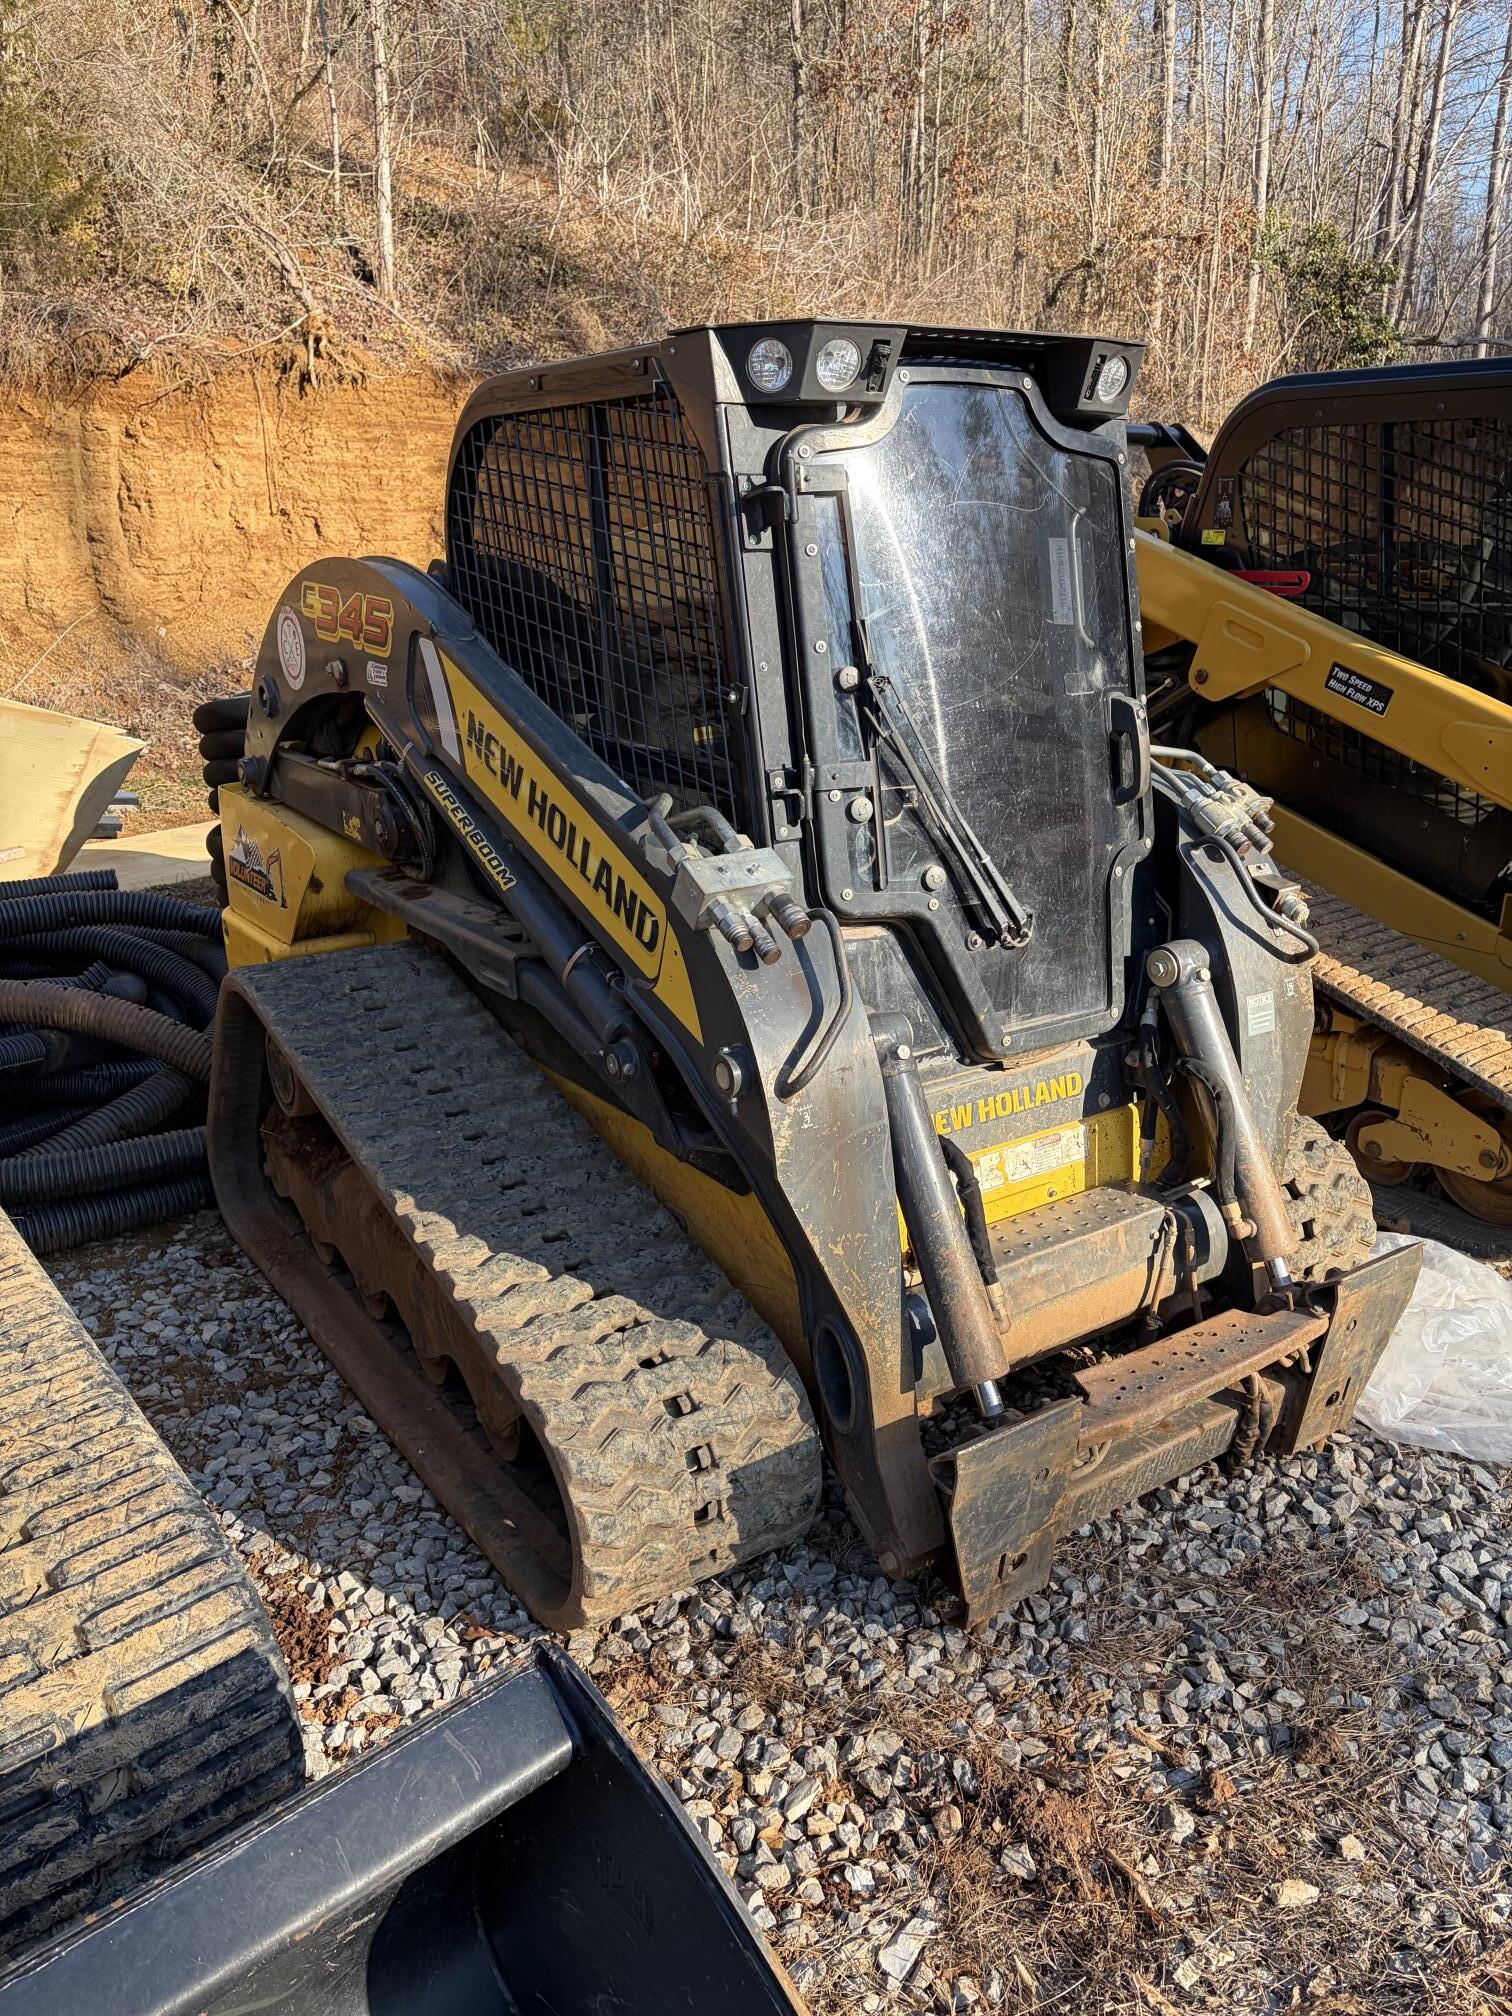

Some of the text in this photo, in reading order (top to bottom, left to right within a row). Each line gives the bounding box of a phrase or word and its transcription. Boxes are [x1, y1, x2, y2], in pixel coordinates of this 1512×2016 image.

[1328, 679, 1385, 712] HIGH FLOW XPS
[1332, 667, 1372, 693] TWO SPEED
[466, 709, 659, 954] NEW HOLLAND
[931, 1072, 1083, 1136] EW HOLLAND
